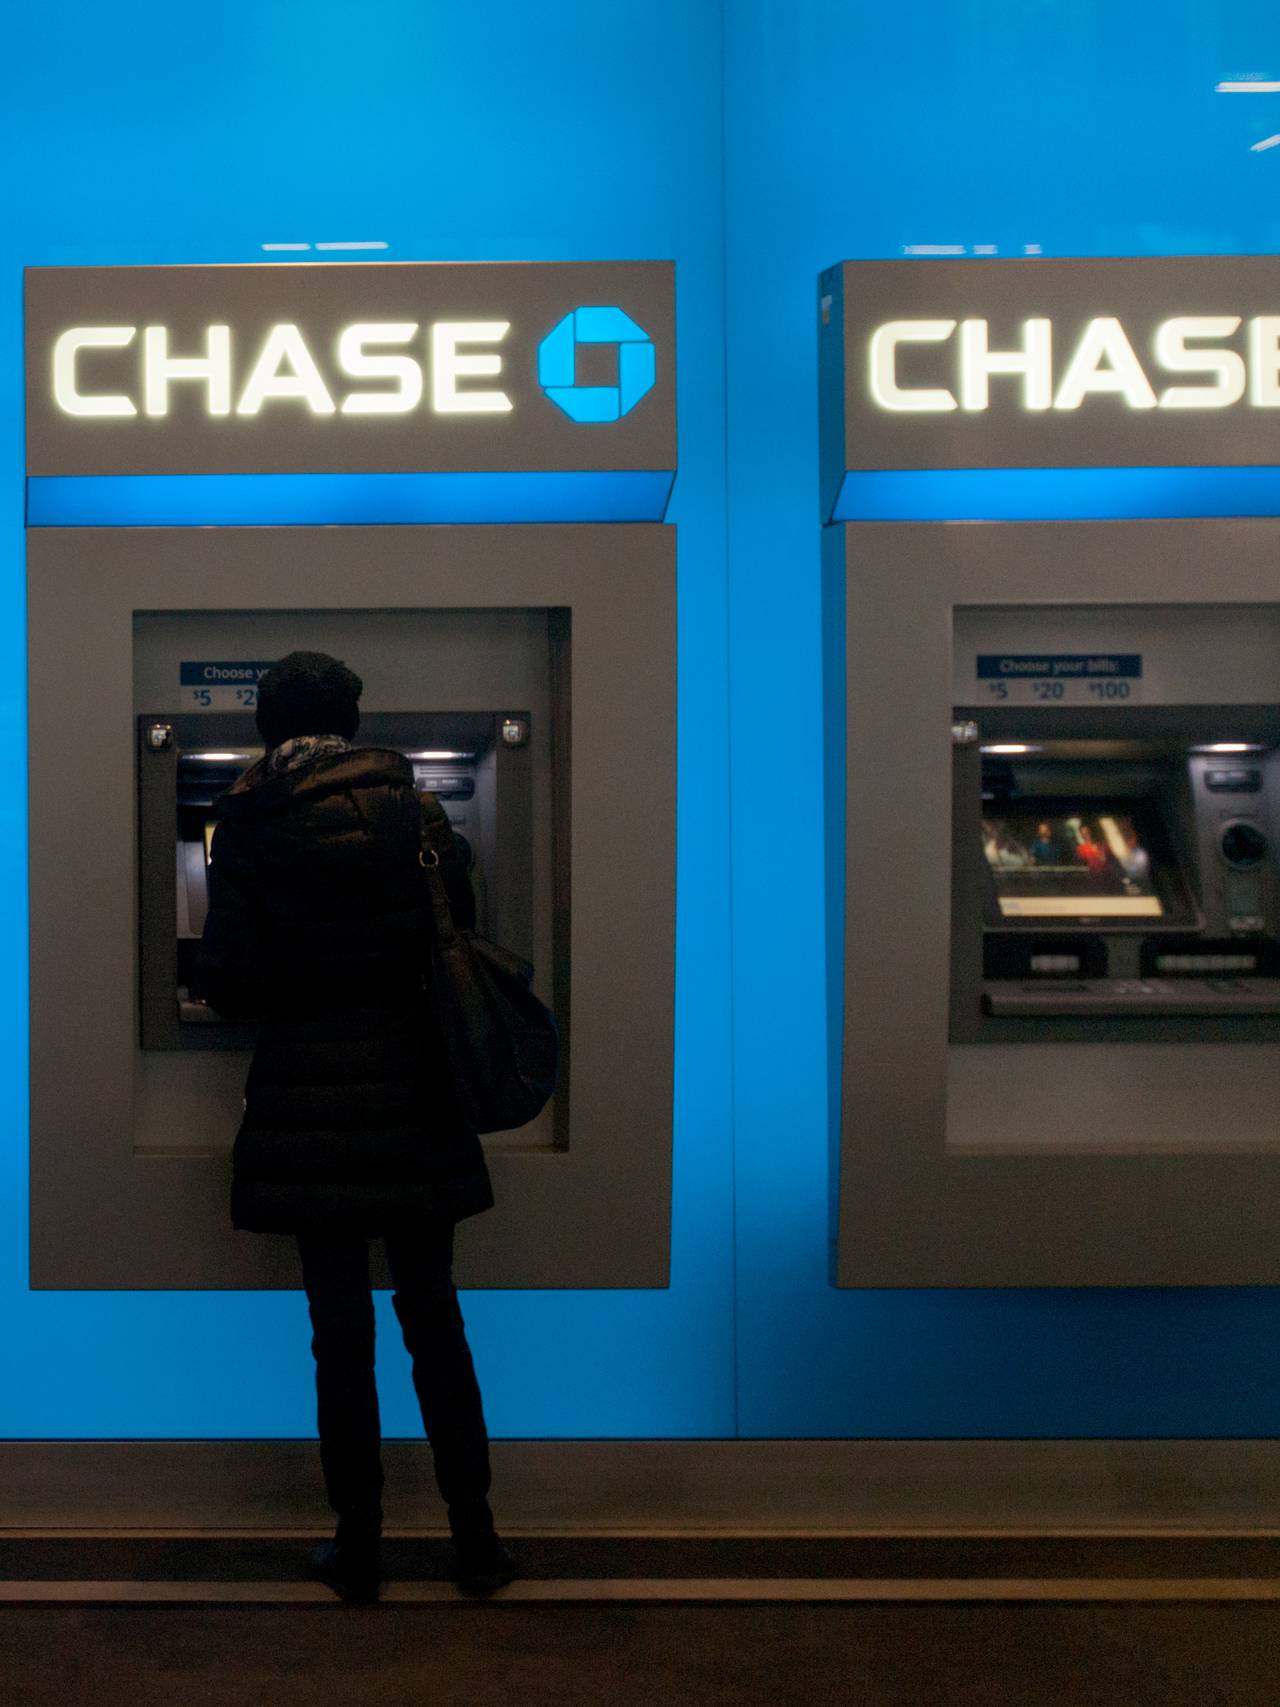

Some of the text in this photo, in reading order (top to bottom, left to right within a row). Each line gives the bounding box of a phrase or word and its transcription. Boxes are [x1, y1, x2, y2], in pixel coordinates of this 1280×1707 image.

[53, 321, 514, 416] CHASE
[203, 666, 254, 679] Choose
[1000, 660, 1050, 673] Choose
[1054, 663, 1083, 675] your
[193, 689, 212, 706] $5
